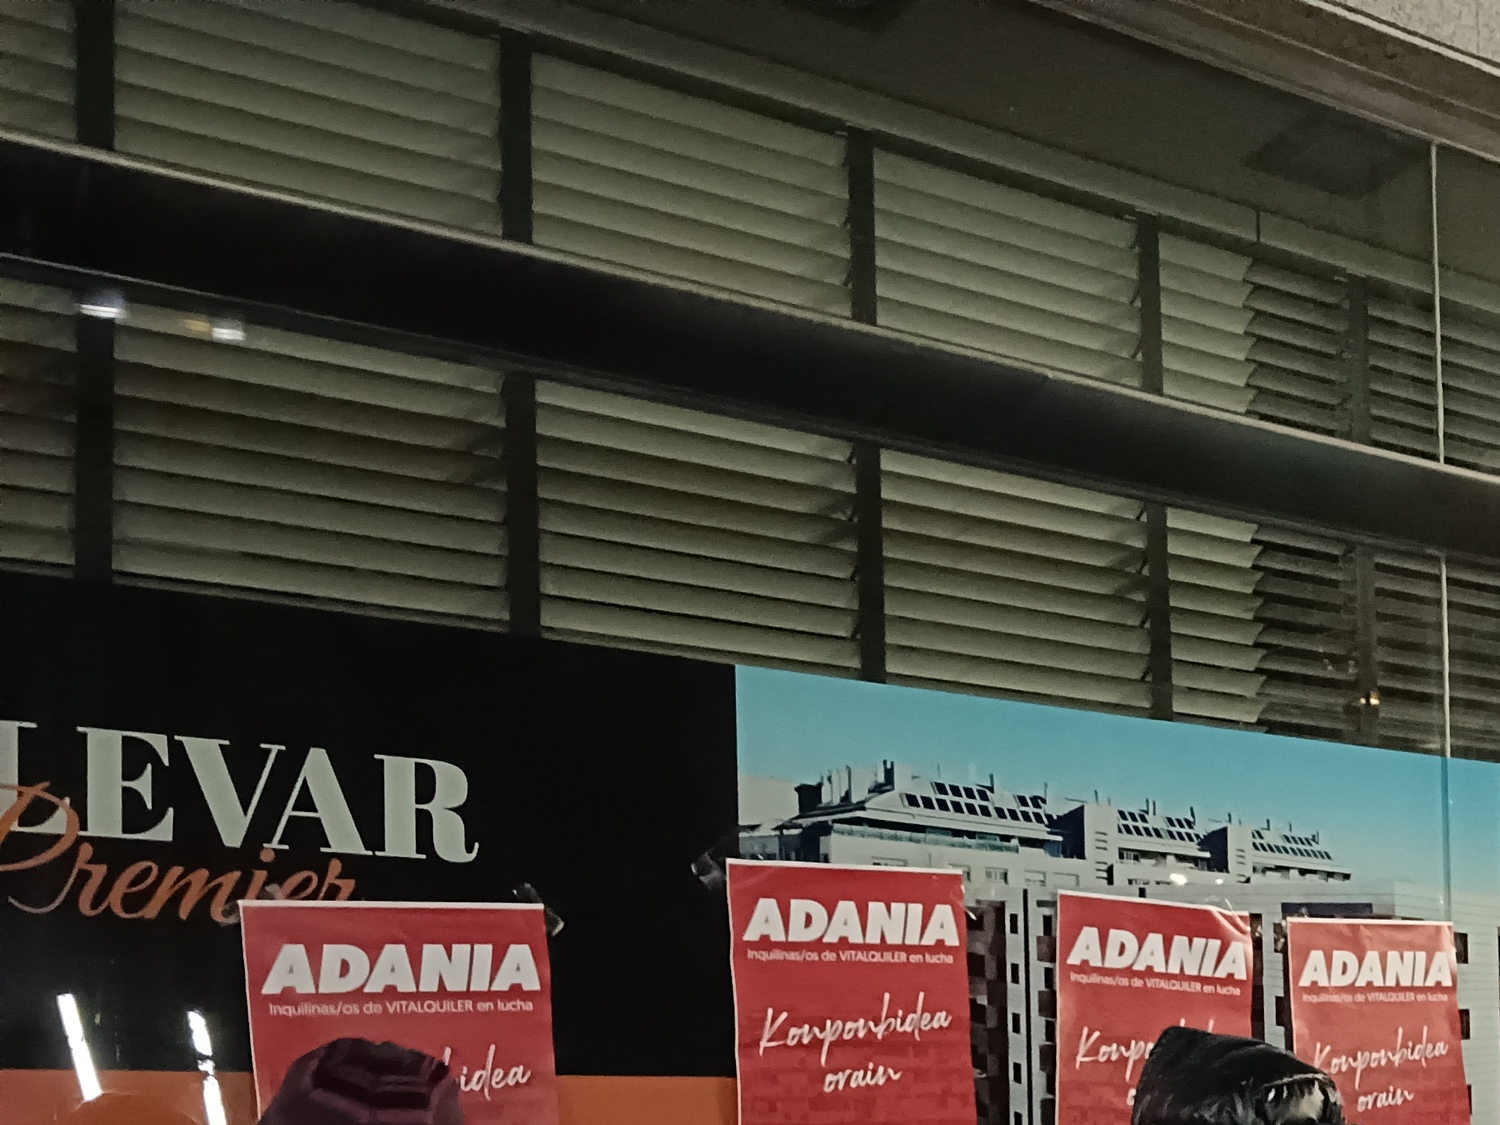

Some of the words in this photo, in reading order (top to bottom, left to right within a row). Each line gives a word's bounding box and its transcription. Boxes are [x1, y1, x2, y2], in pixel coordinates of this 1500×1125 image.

[742, 898, 960, 946] ADANIA
[261, 943, 541, 994] ADANIA
[747, 948, 819, 962] Inquilinas/os
[821, 950, 837, 961] de
[839, 951, 907, 963] VITALQUILER
[909, 954, 923, 963] en
[925, 951, 953, 964] lucha
[1066, 926, 1247, 980] ADANIA
[1298, 950, 1453, 987] ADANIA
[1131, 977, 1144, 987] de
[1145, 978, 1202, 993] VITALQUILER
[1203, 986, 1215, 994] en
[1217, 985, 1241, 996] lucha
[269, 1002, 360, 1018] Inquilinas/os
[363, 1002, 383, 1014] de
[385, 1000, 473, 1014] VITALQUILER
[477, 1002, 494, 1012] en
[497, 999, 533, 1012] lucha
[759, 991, 952, 1067] Konponbidea
[823, 1061, 903, 1093] orain
[1357, 1085, 1415, 1112] orain
